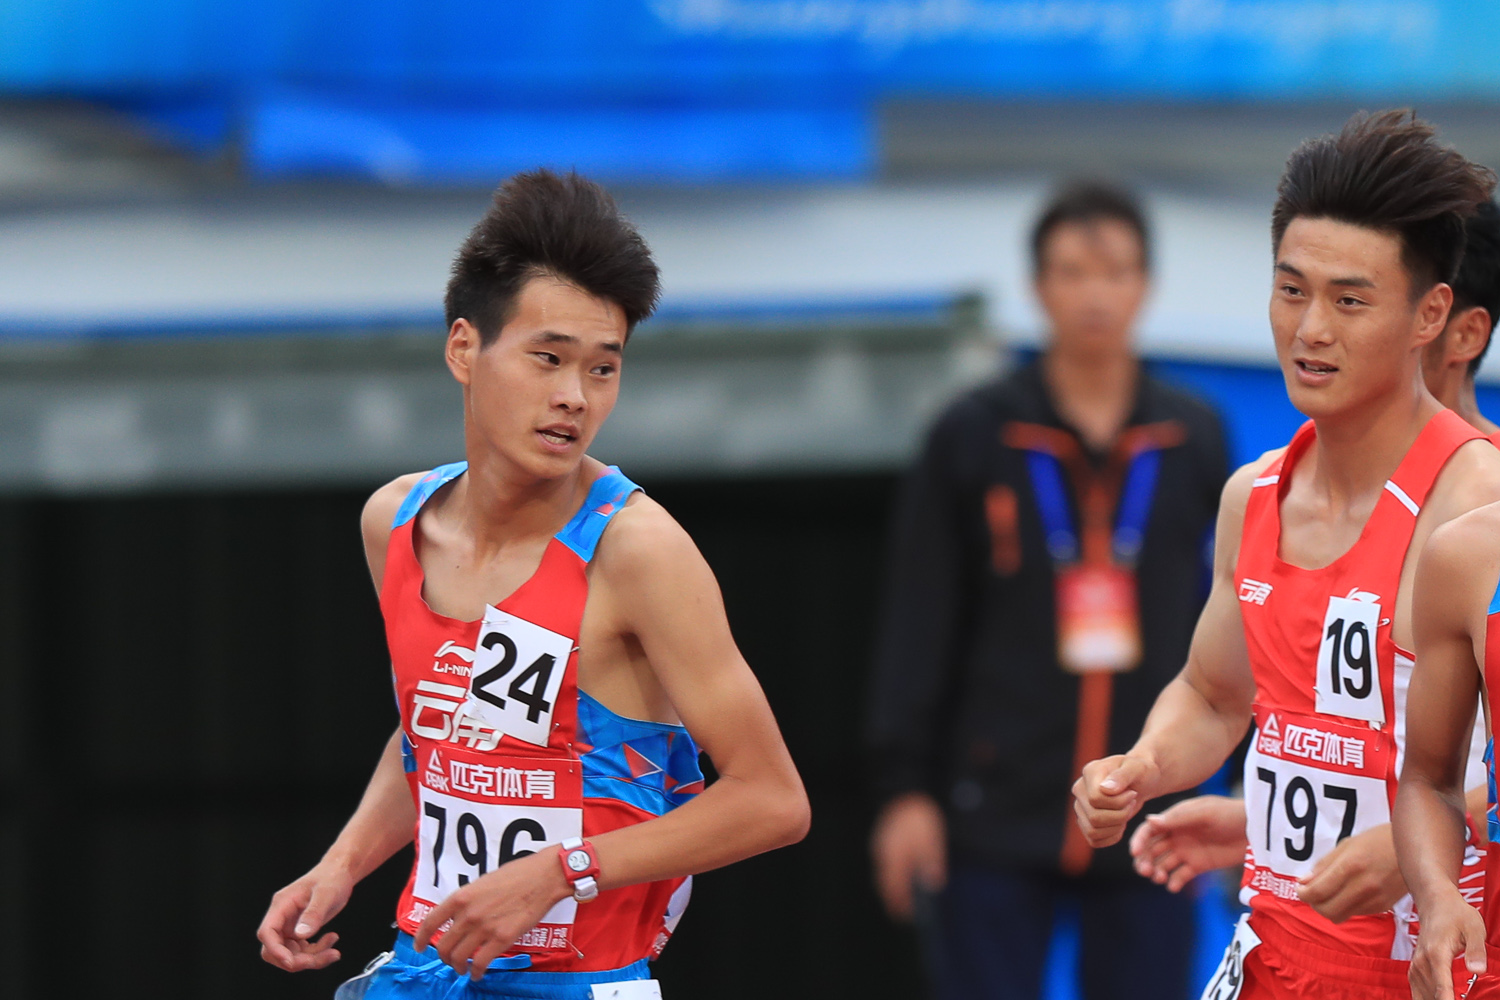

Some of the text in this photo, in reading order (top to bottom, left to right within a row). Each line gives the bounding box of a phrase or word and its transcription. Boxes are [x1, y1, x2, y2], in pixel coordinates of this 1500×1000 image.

[433, 660, 472, 678] LI-NIN
[471, 631, 551, 724] 24
[1326, 618, 1373, 700] 19
[1284, 724, 1365, 769] 匹克体育
[450, 760, 555, 799] 匹克体育
[1257, 766, 1357, 861] 797
